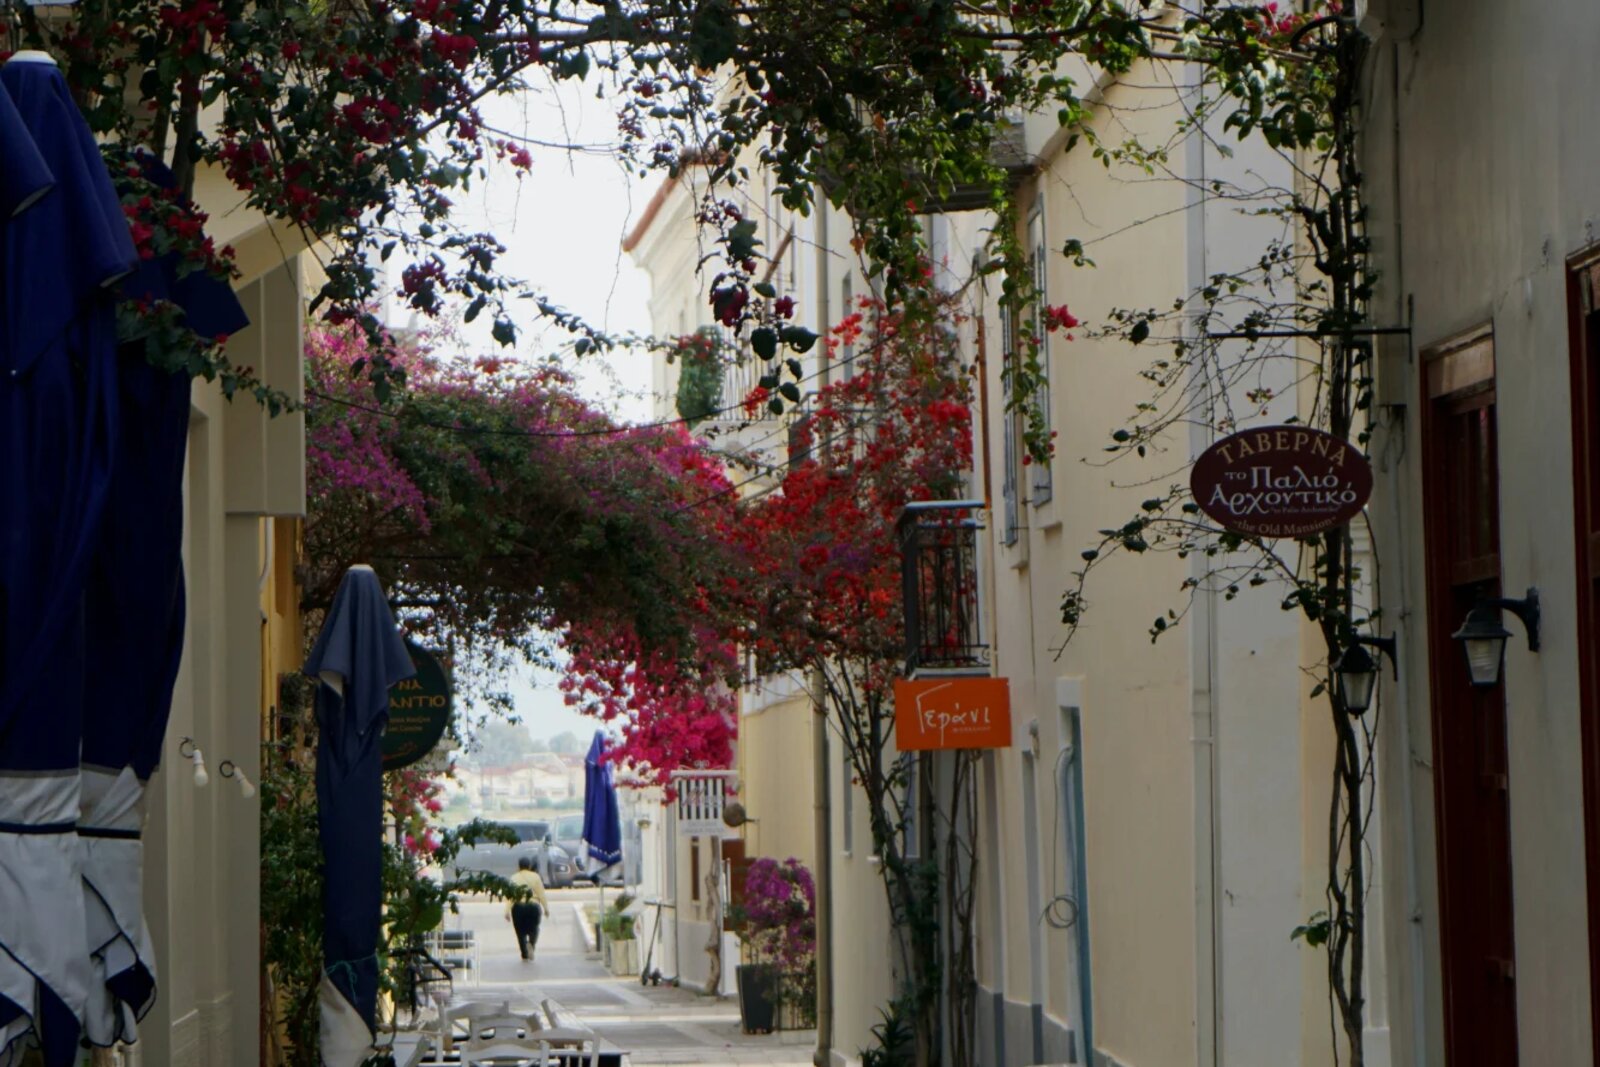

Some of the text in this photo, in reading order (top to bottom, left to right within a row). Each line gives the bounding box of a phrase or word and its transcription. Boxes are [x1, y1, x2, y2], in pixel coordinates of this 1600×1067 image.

[1216, 431, 1347, 467] ΤΑΒΕΡΝΑ
[1250, 465, 1339, 490] Παλιό
[1208, 482, 1357, 515] Αρχοντικό
[1258, 523, 1281, 535] Old
[389, 695, 446, 708] ΑΝΤΙΟ
